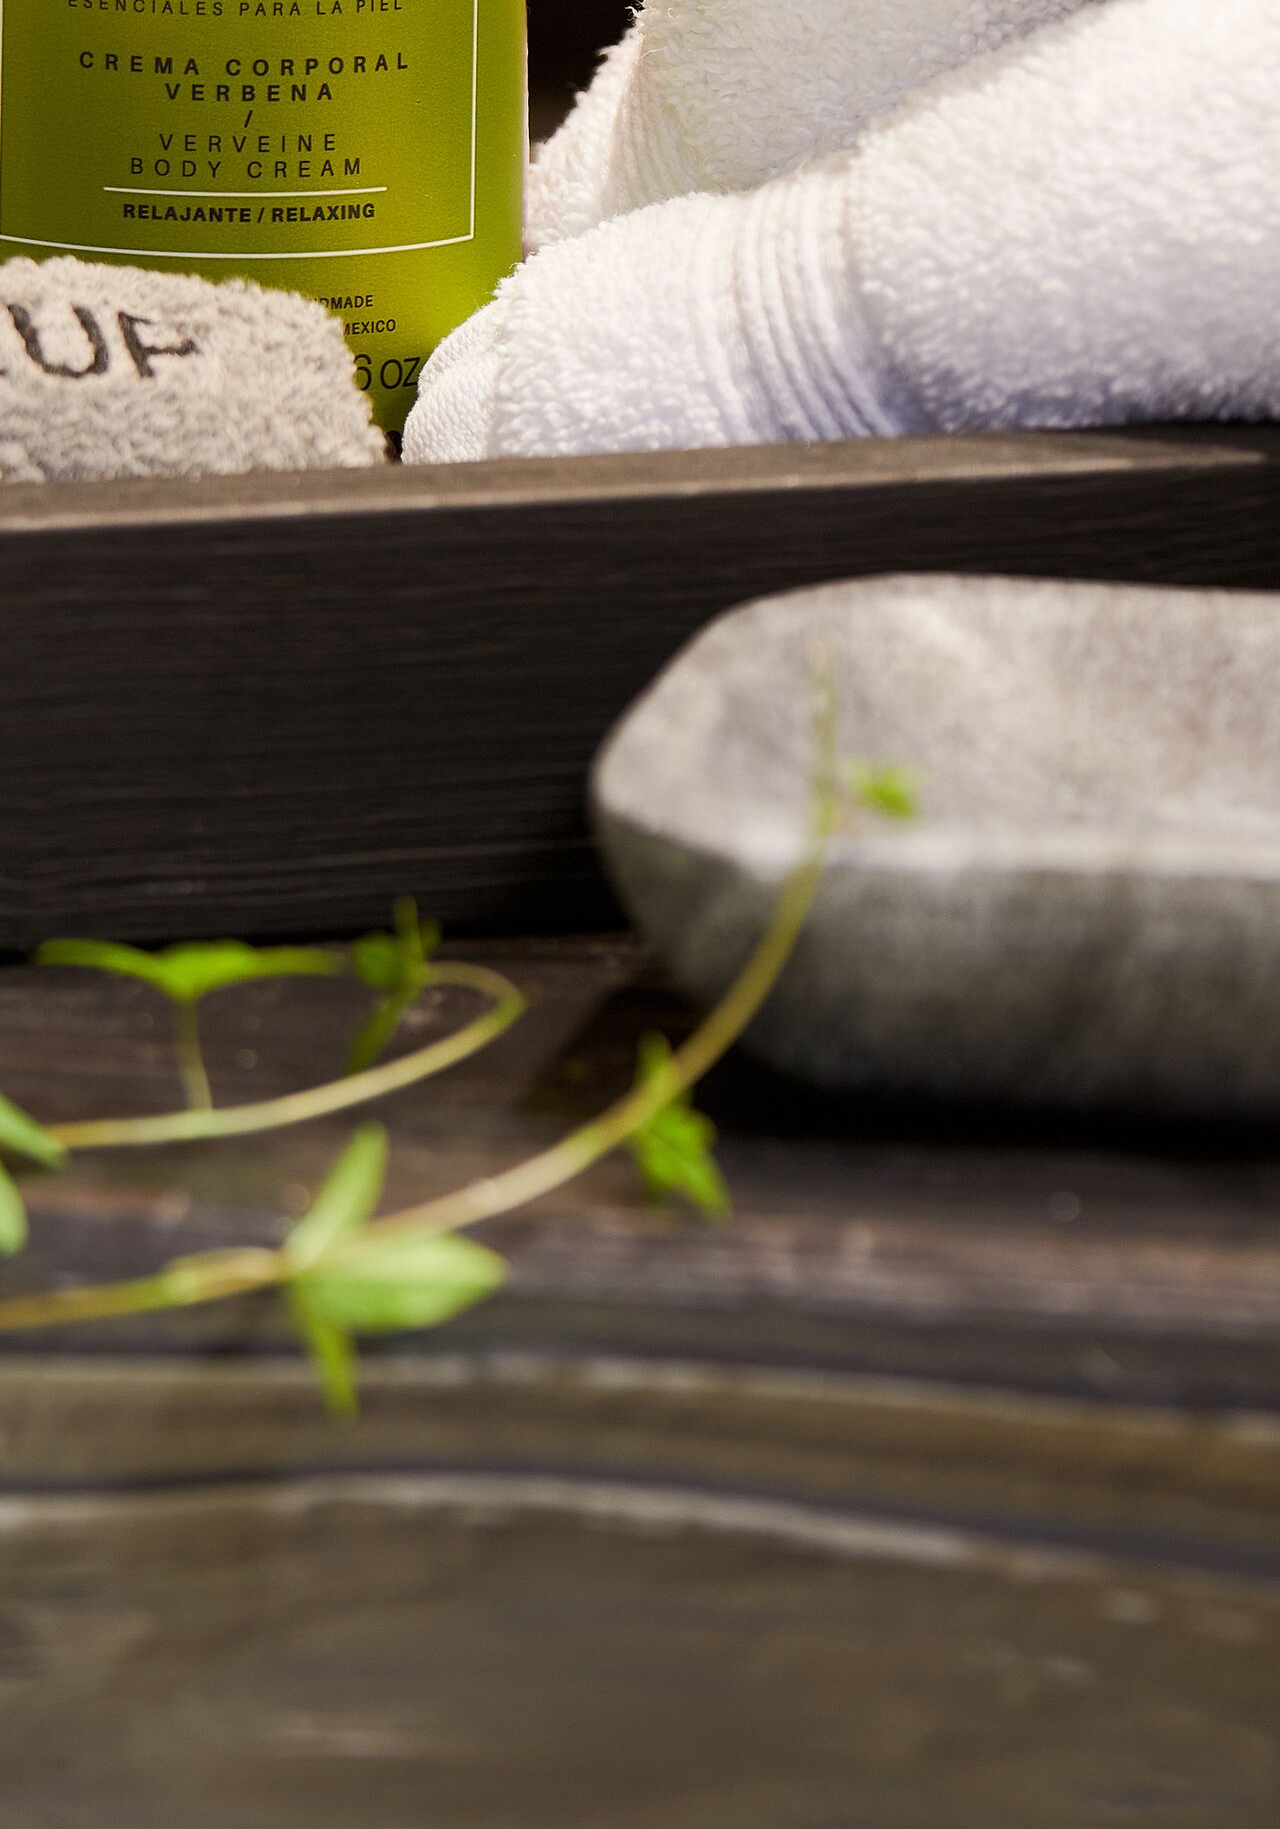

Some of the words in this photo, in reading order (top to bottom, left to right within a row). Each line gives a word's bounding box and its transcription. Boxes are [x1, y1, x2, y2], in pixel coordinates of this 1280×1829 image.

[239, 1, 301, 17] PARA
[316, 0, 343, 16] LA
[78, 51, 200, 76] CREMA
[224, 52, 408, 77] CORPORAL
[164, 82, 332, 103] VERBENA
[158, 132, 335, 154] VERVEINE
[130, 157, 222, 178] BODY
[245, 157, 360, 180] CREAM
[122, 203, 252, 223] RELAJANTE
[270, 203, 375, 224] RELAXING
[310, 294, 374, 310] DMADE
